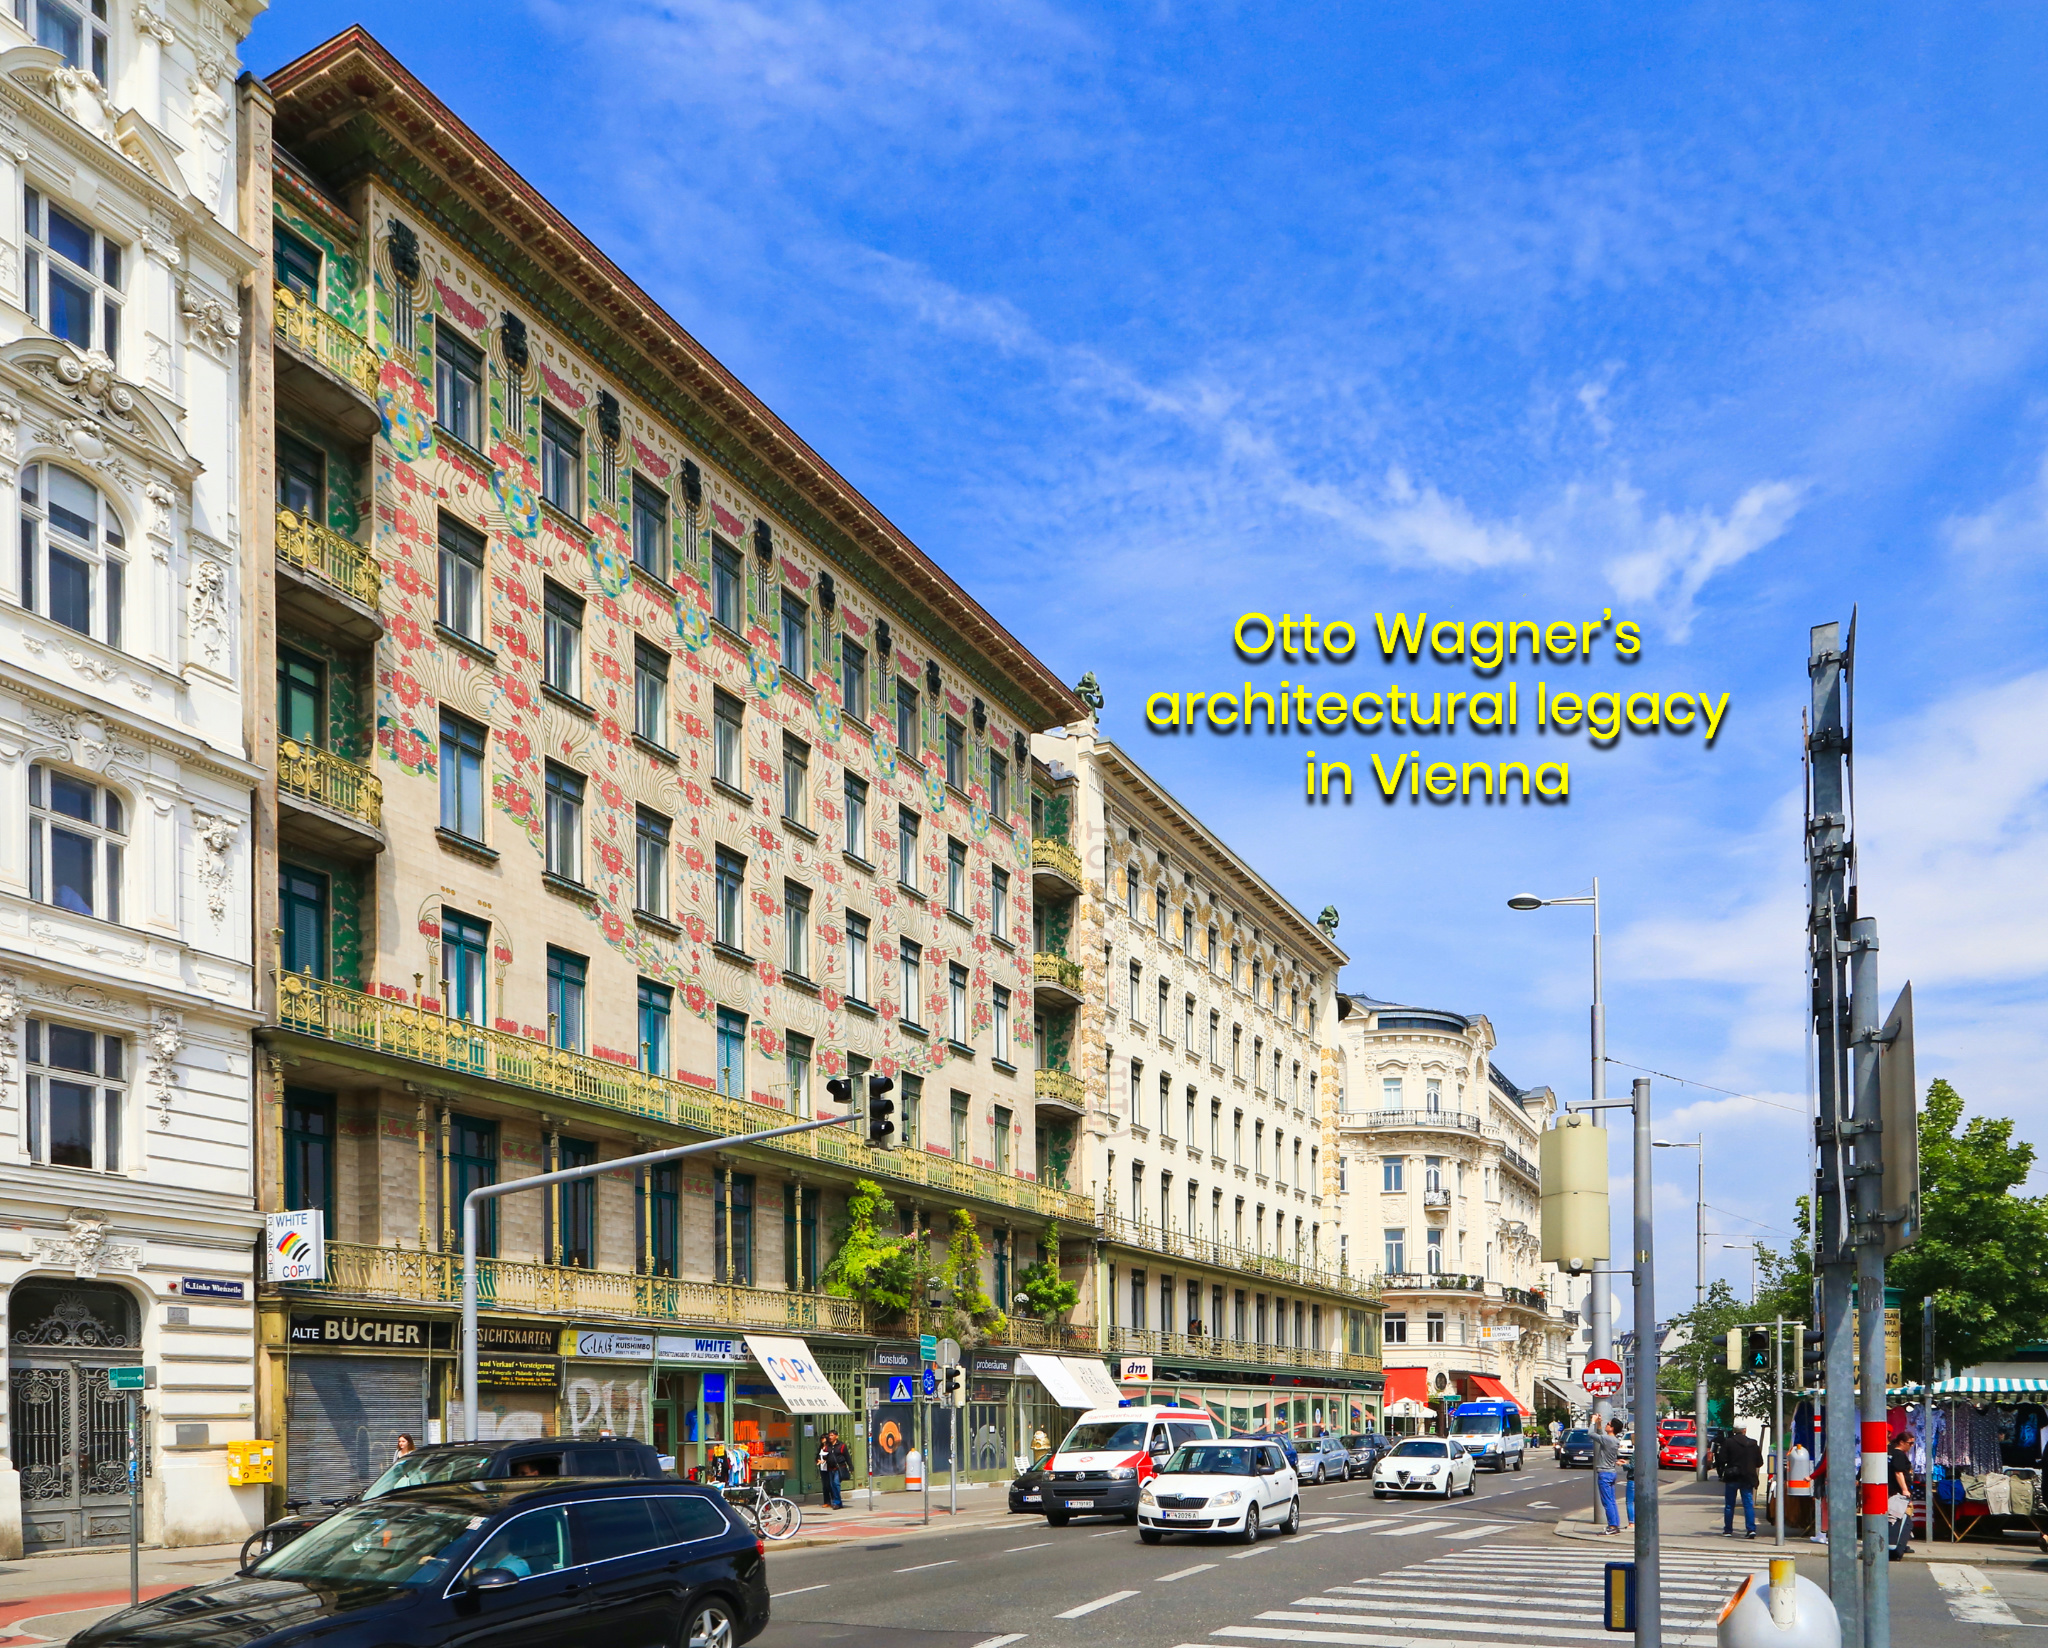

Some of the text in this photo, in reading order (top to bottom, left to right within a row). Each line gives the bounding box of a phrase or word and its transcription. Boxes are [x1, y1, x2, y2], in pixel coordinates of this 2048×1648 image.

[276, 1213, 308, 1228] WHITE
[282, 1264, 311, 1278] COPY
[212, 1284, 242, 1294] Wienzeile
[291, 1316, 420, 1344] ALTE BÜCHER
[477, 1327, 552, 1346] SICHTSKARTEN
[615, 1342, 651, 1350] KUISHIMBO
[695, 1338, 732, 1353] WHITE
[479, 1360, 556, 1370] und Verkauf Versteigerung
[879, 1353, 908, 1366] tonstudio
[976, 1359, 1008, 1371] proberäume
[767, 1356, 820, 1383] COPY
[1127, 1361, 1146, 1375] dm
[788, 1396, 806, 1407] und
[806, 1397, 829, 1408] mehr
